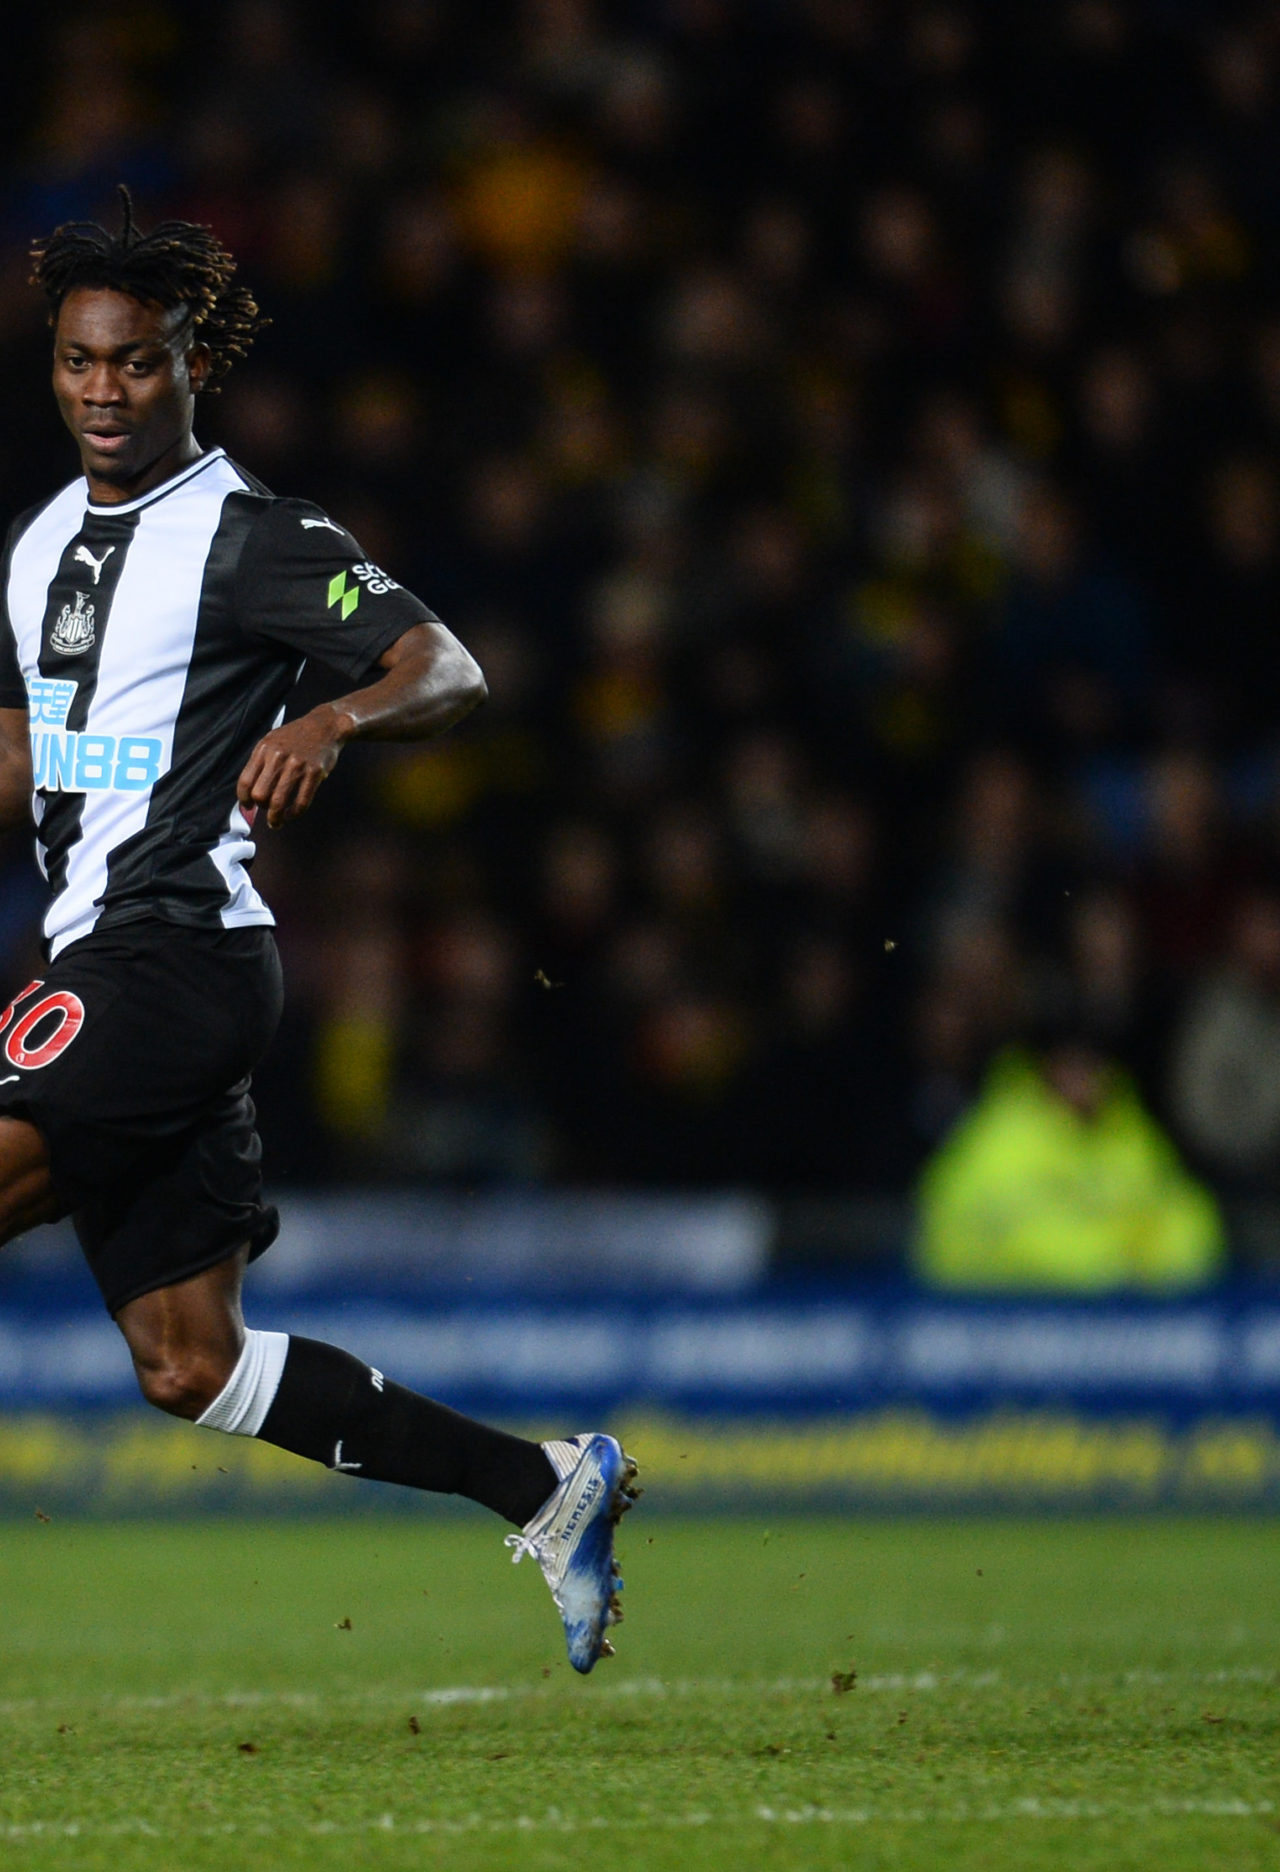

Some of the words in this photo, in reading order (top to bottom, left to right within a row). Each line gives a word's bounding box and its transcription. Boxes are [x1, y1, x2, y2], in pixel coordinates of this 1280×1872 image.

[27, 681, 75, 725] 天堂
[32, 732, 163, 791] UN88
[561, 1477, 600, 1541] NEMESIS
